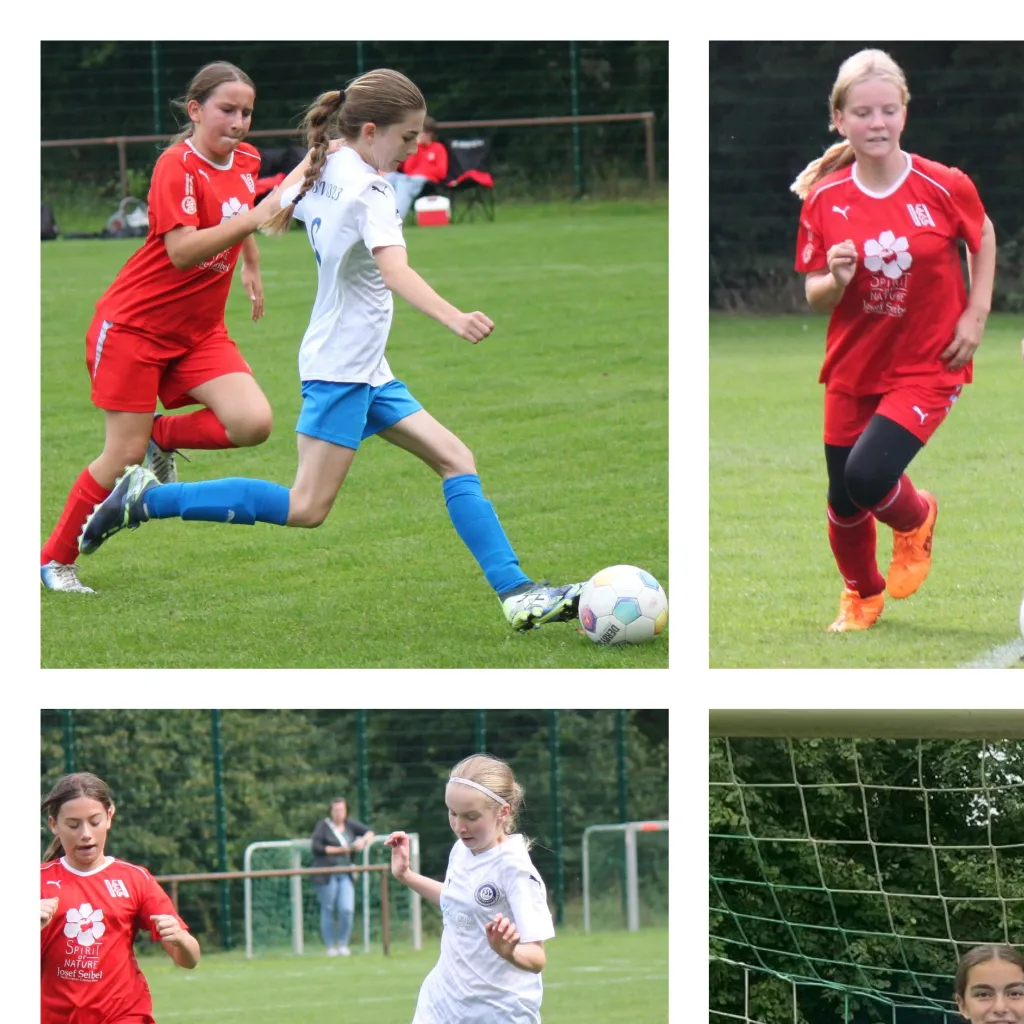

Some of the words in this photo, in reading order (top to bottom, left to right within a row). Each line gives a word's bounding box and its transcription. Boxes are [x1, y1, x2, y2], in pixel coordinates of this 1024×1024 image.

[64, 959, 99, 970] NATURE
[57, 966, 77, 977] Josef
[78, 970, 103, 980] Seibel
